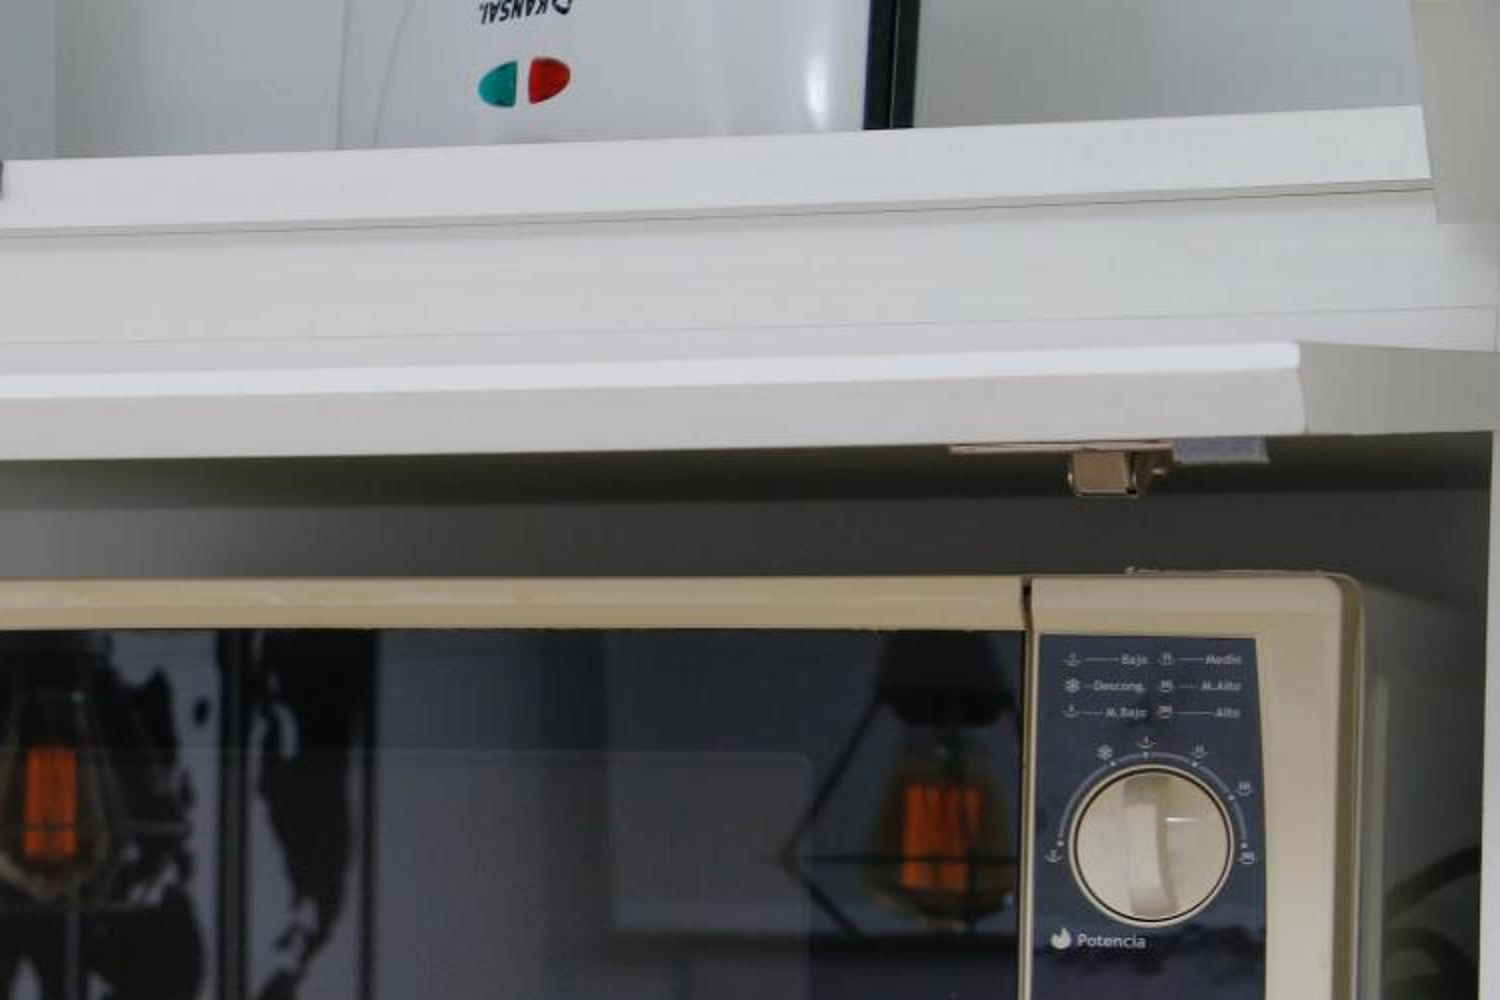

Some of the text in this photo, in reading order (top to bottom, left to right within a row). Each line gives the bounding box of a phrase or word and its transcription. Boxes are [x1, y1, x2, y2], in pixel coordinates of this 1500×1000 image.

[1121, 654, 1149, 668] Bajo
[1204, 654, 1242, 666] Medio
[1215, 707, 1241, 719] Alto
[1076, 932, 1146, 948] Potencia
